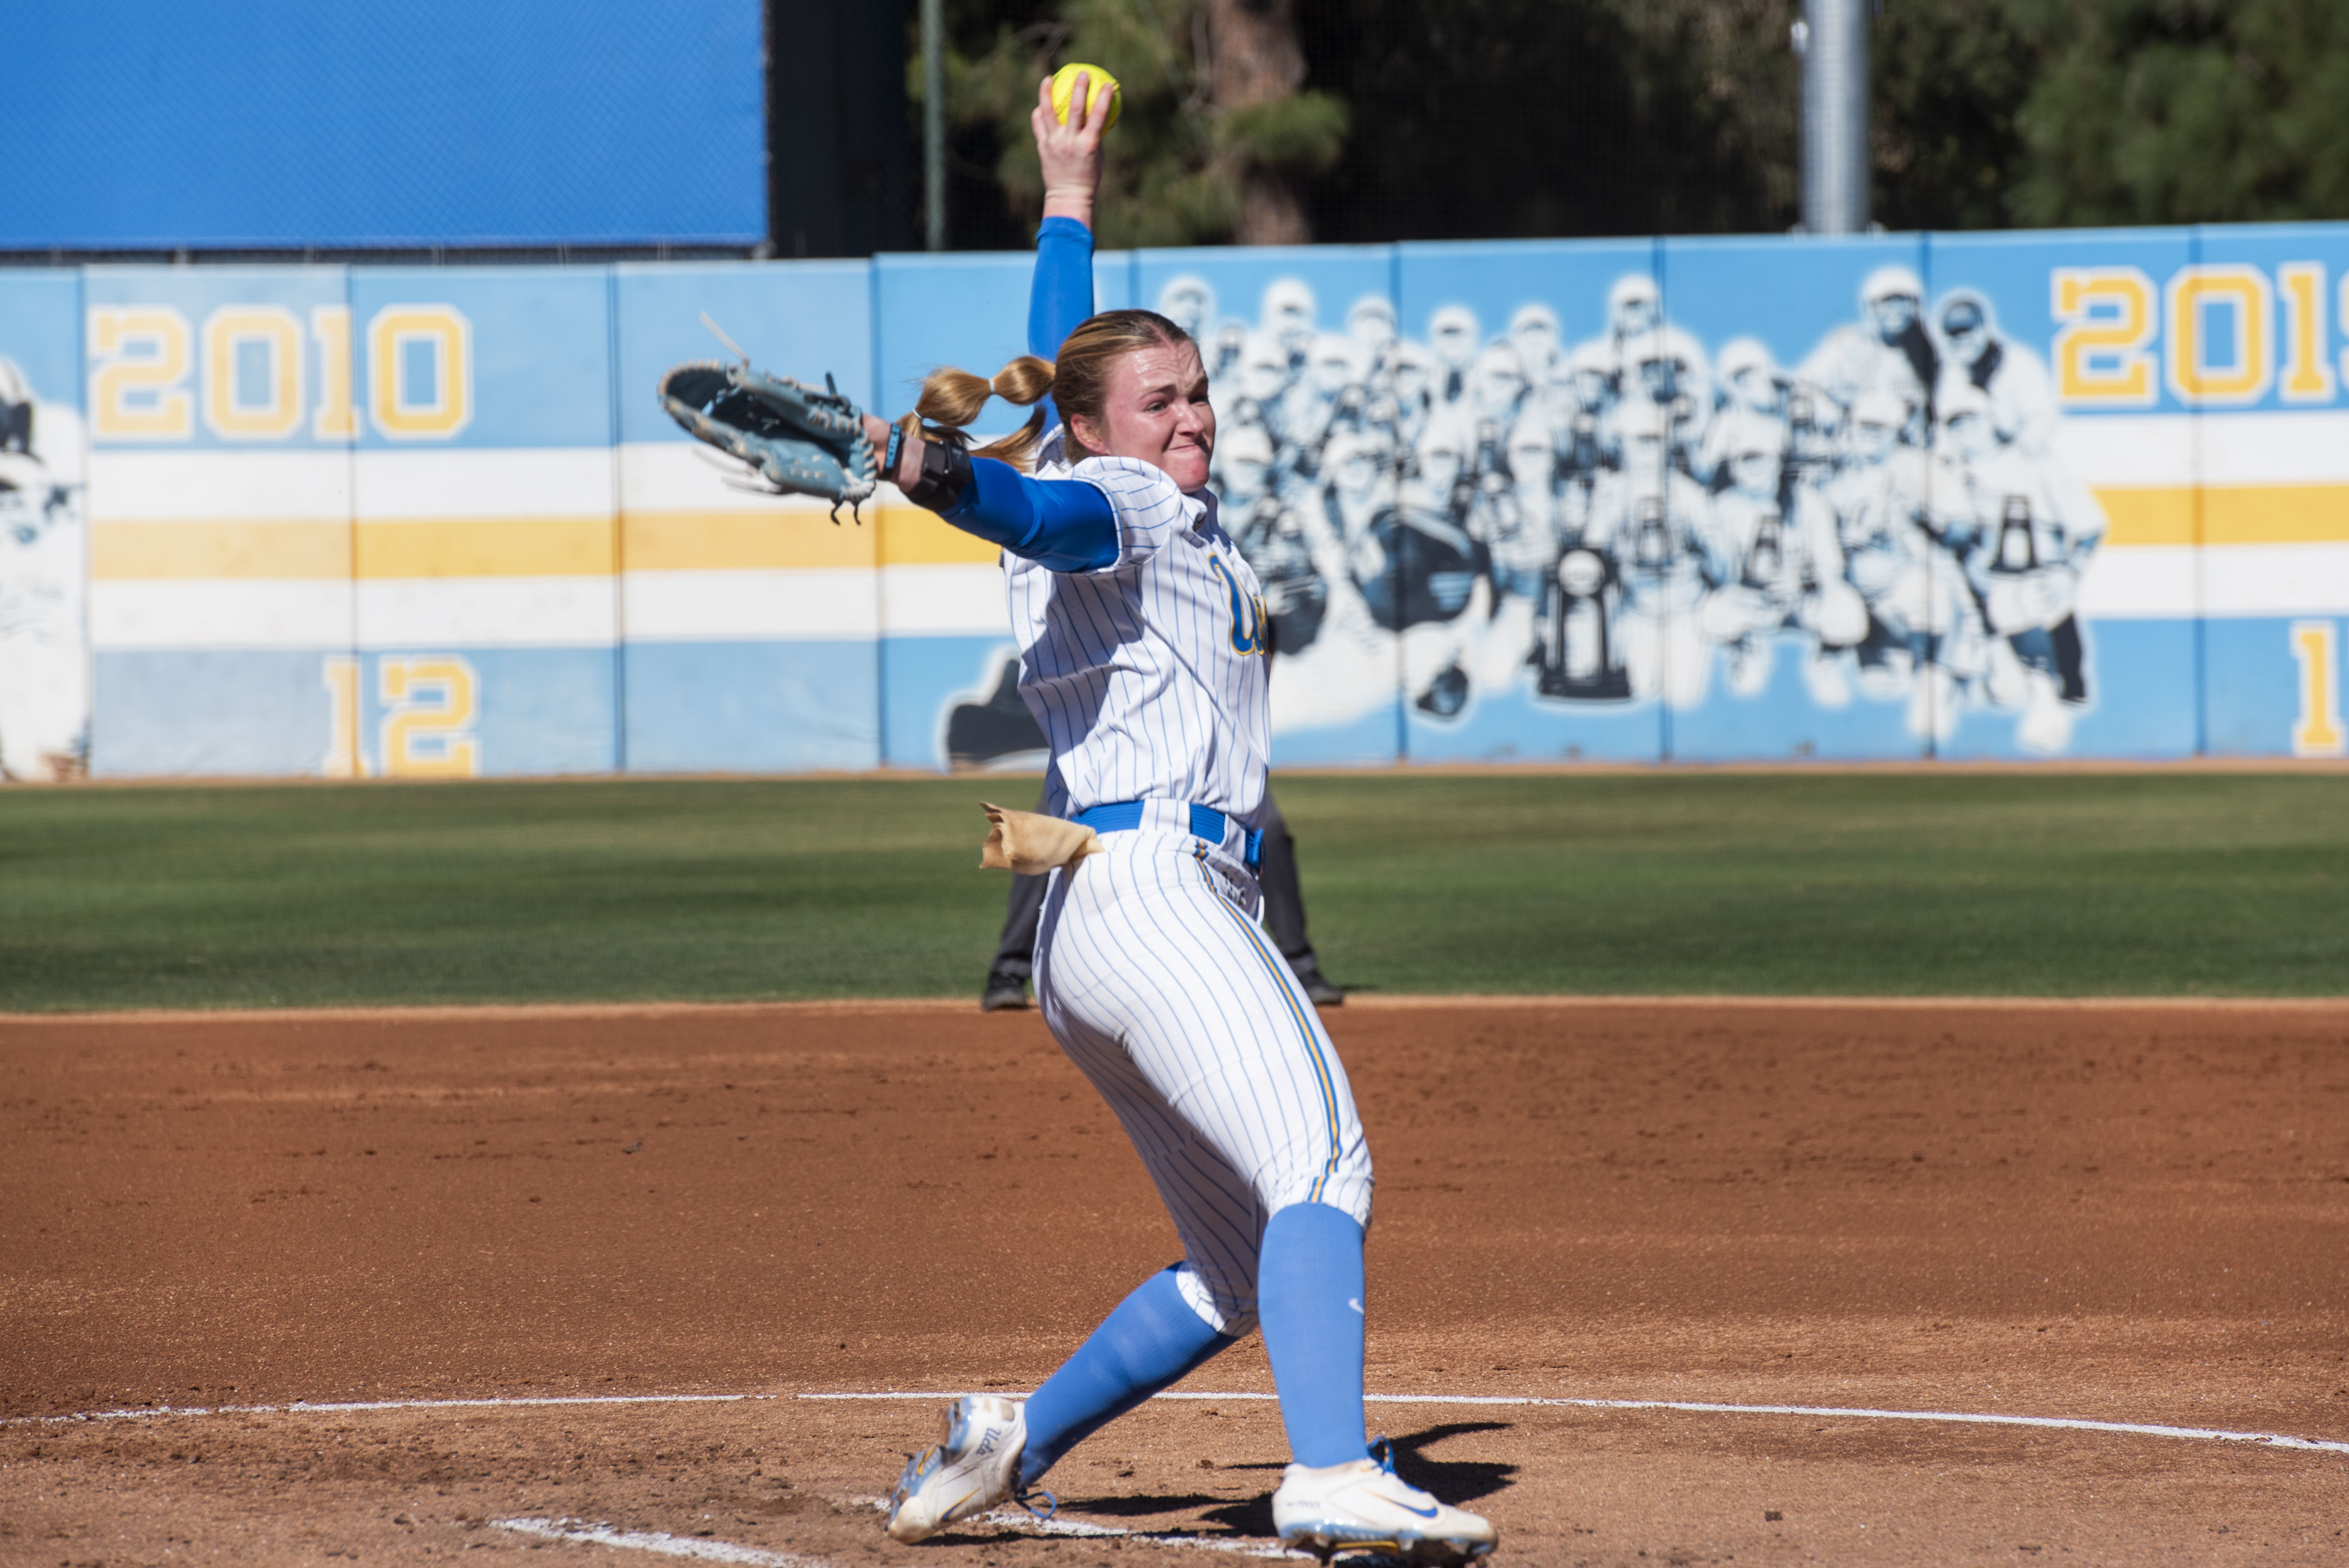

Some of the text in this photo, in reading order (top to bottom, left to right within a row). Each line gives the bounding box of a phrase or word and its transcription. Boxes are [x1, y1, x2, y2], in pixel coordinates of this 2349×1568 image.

[89, 304, 473, 441] 2010
[2050, 260, 2349, 408] 201
[324, 653, 480, 777] 12
